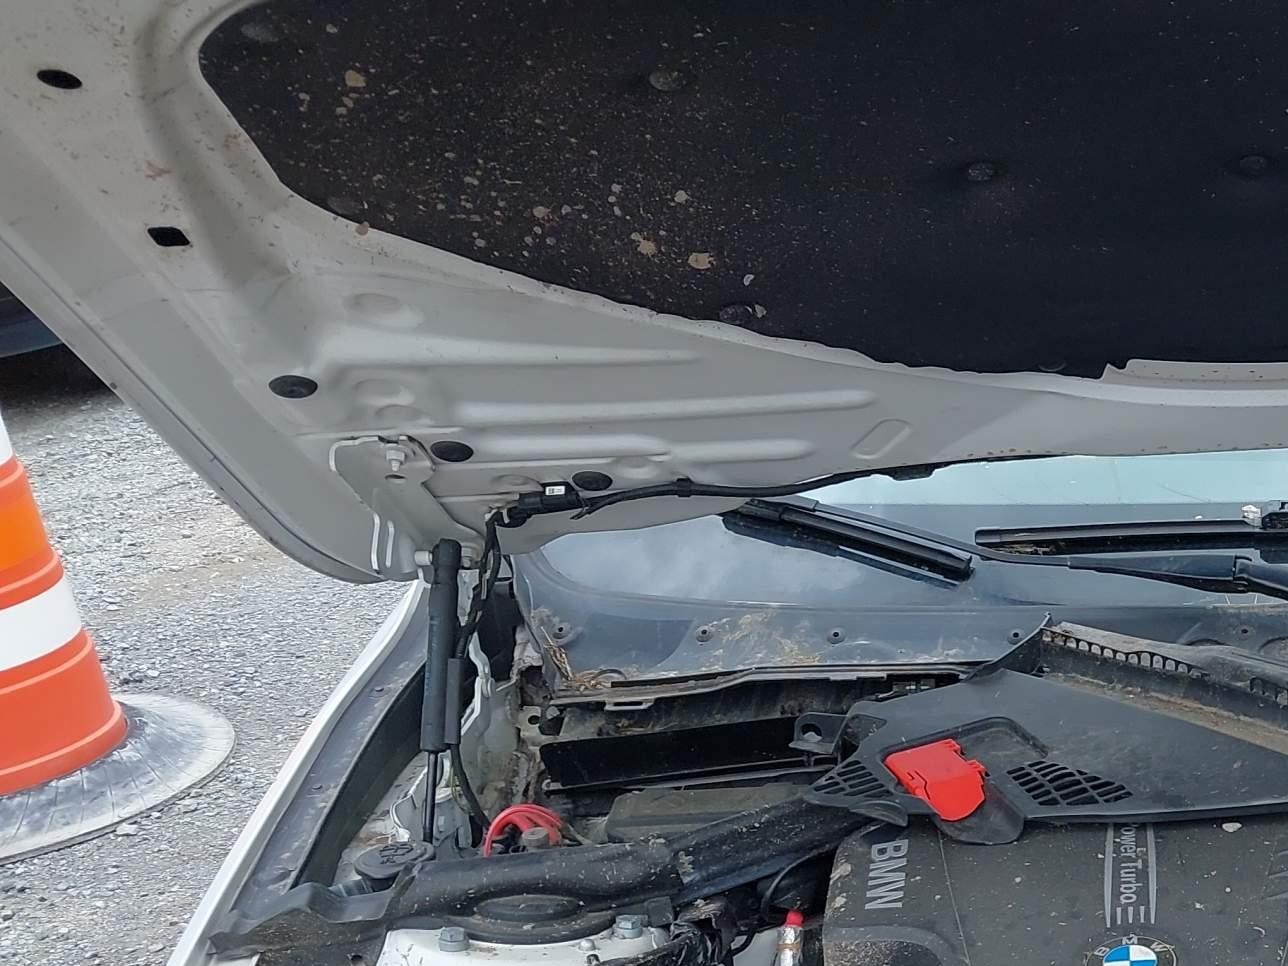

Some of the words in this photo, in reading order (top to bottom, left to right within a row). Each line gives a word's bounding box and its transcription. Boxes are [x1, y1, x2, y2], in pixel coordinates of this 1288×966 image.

[865, 839, 909, 910] BMW
[1119, 859, 1143, 904] Turbo
[1094, 933, 1175, 957] BMW
